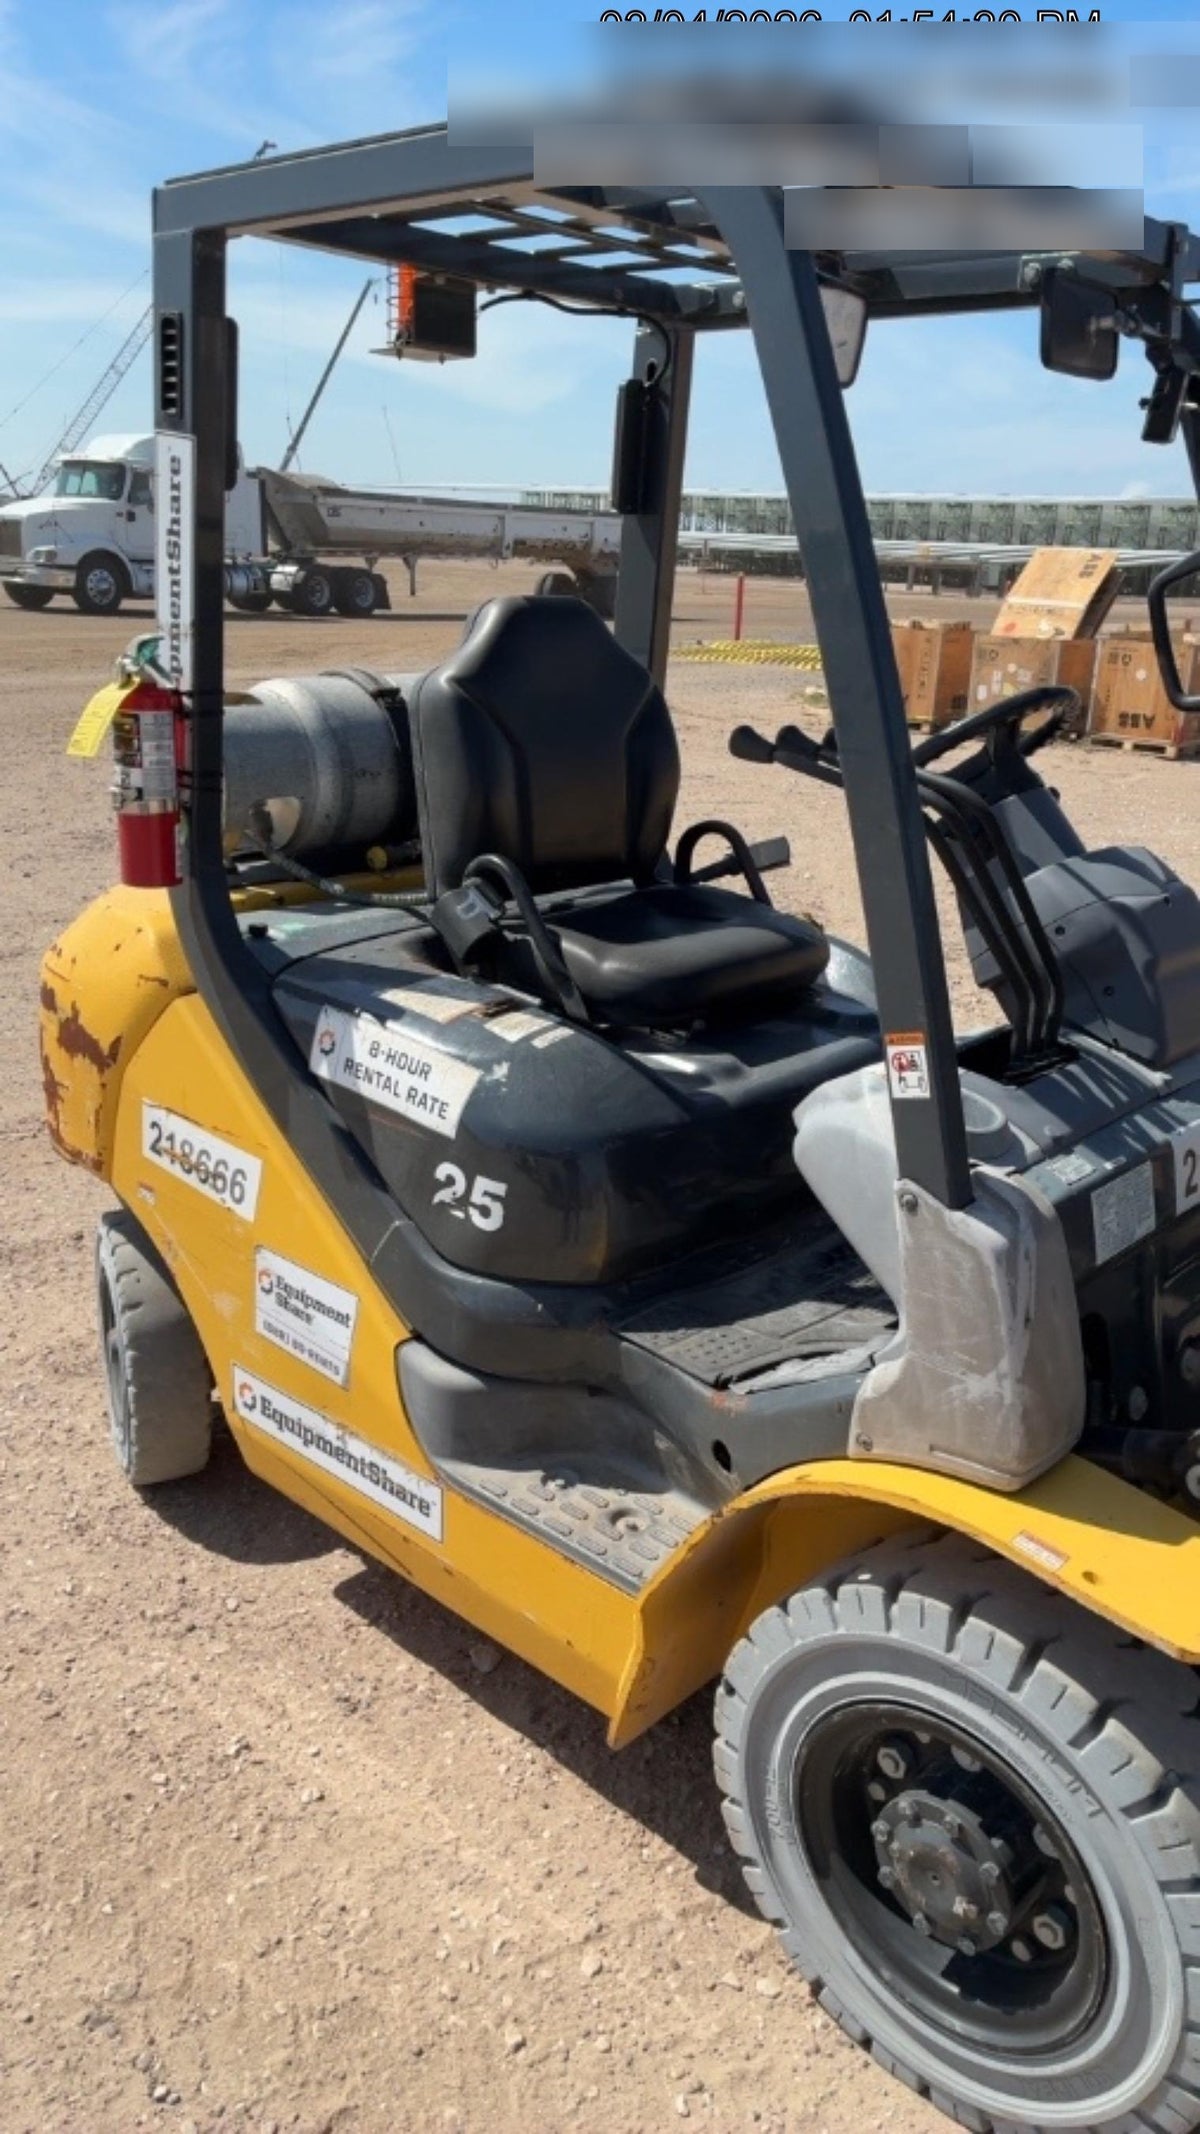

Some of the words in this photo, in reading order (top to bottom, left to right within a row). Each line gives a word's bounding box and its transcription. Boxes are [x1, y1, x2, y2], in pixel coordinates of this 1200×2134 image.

[166, 455, 181, 682] pmentShare
[1119, 713, 1155, 729] ABB
[343, 1057, 401, 1099] RENTAL
[405, 1085, 449, 1120] RATE
[367, 1040, 432, 1082] 8-HOUR
[149, 1121, 247, 1205] 218666
[431, 1161, 508, 1232] 25
[275, 1275, 350, 1328] Equipment
[260, 1396, 430, 1518] EquipmentShare
